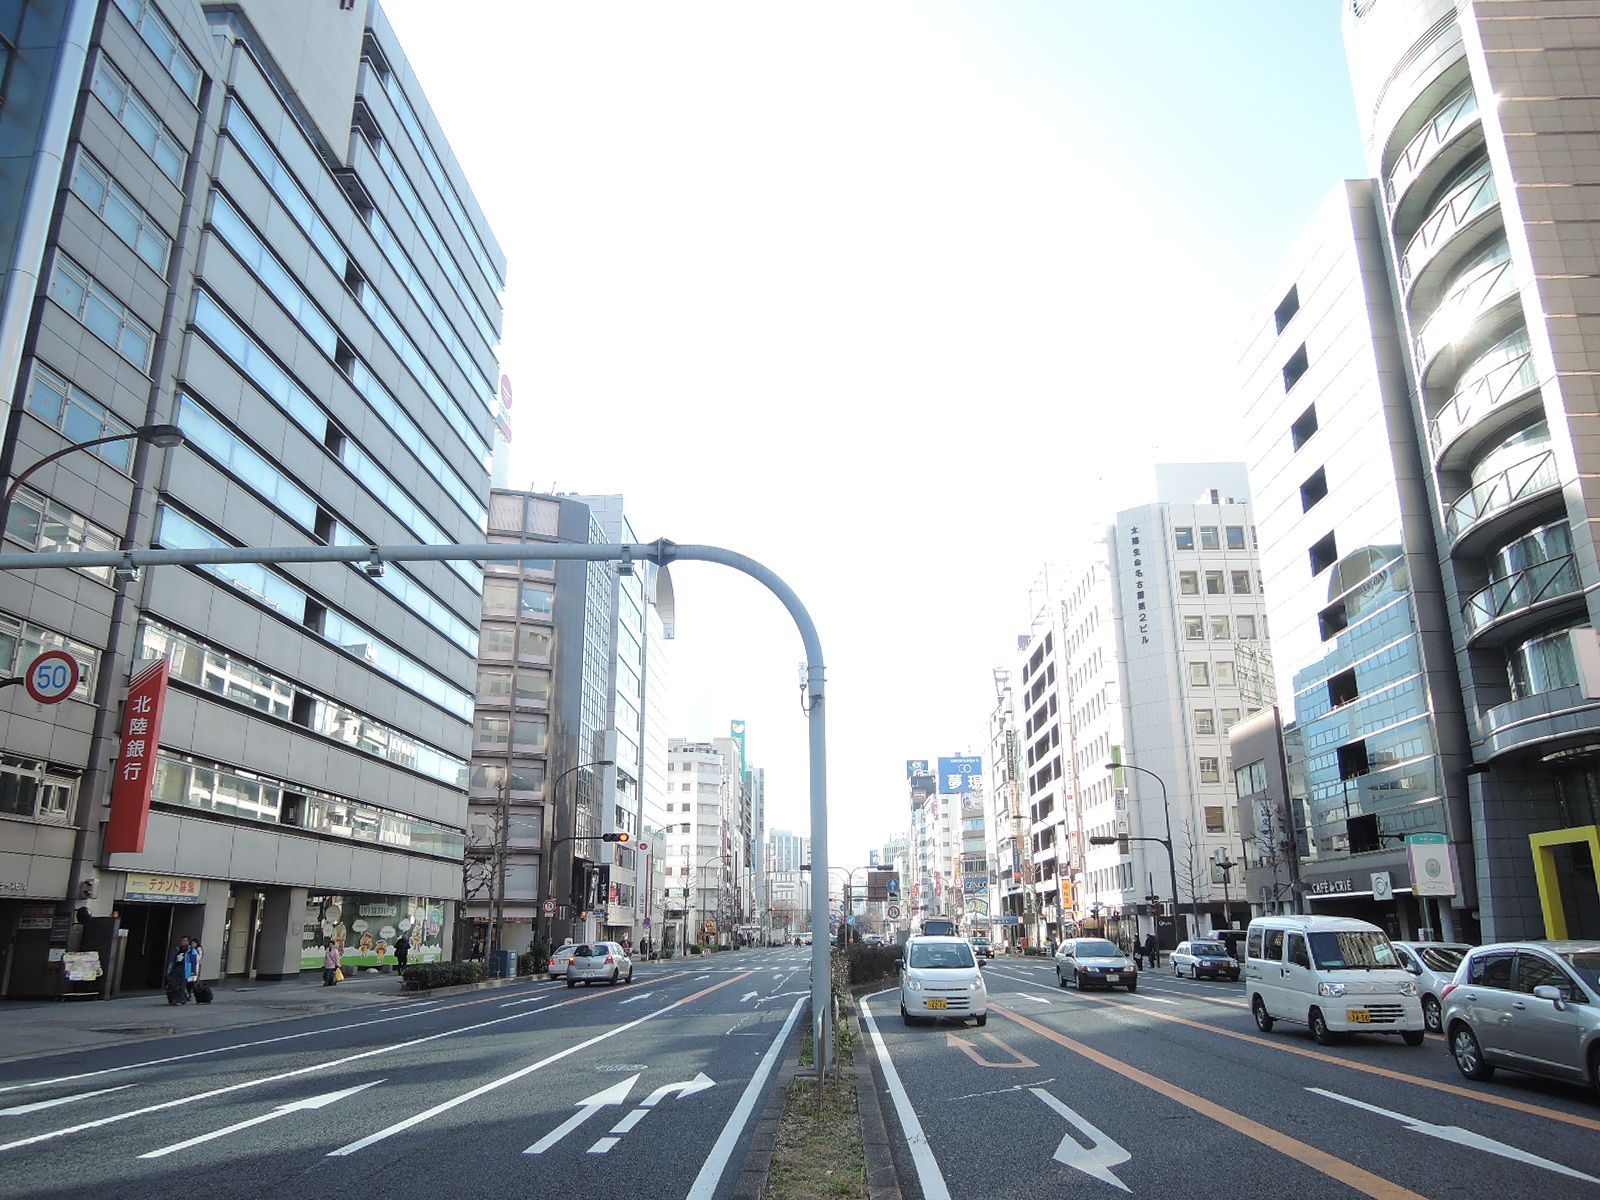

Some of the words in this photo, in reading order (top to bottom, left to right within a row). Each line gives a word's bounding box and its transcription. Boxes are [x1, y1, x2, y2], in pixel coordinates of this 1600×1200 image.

[37, 665, 67, 690] 50
[123, 695, 152, 781] 北陸銀行
[149, 878, 195, 894] テナント募集
